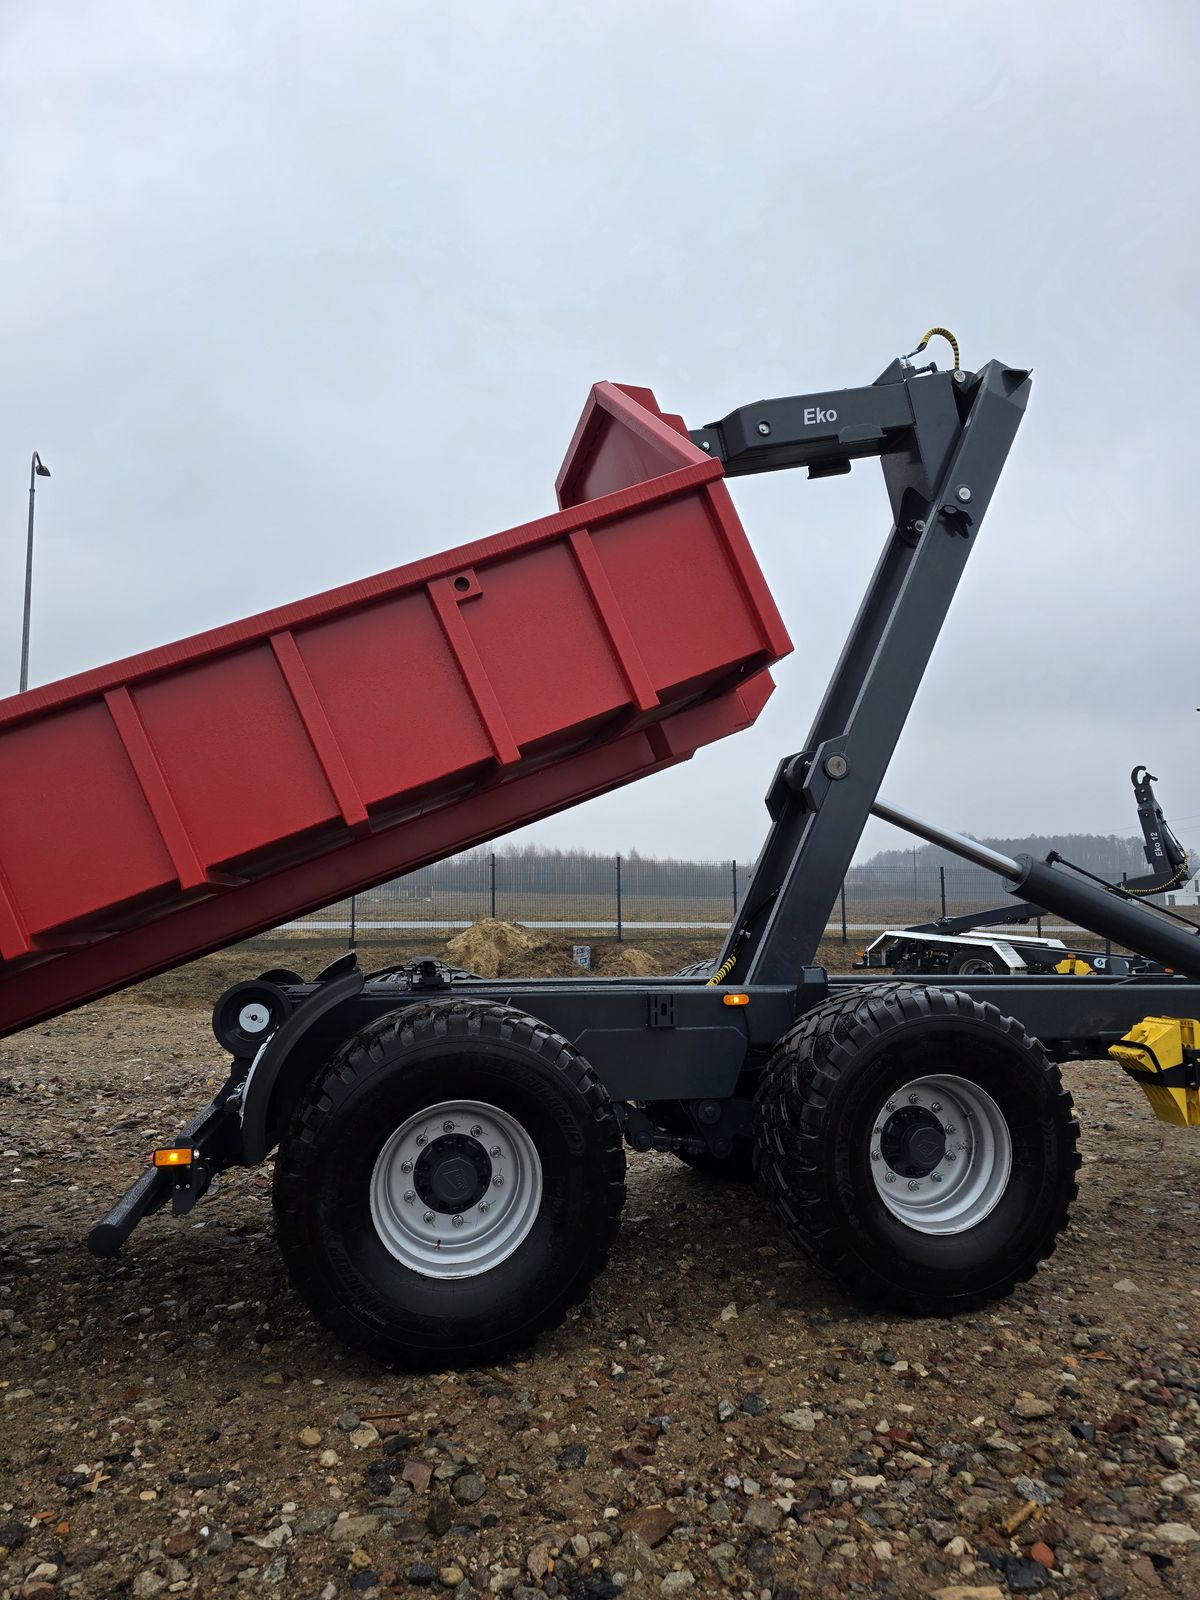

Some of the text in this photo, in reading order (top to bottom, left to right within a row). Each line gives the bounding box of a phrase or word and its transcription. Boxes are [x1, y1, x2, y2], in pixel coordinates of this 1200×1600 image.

[803, 407, 837, 425] Eko
[1150, 831, 1163, 857] Eko 12
